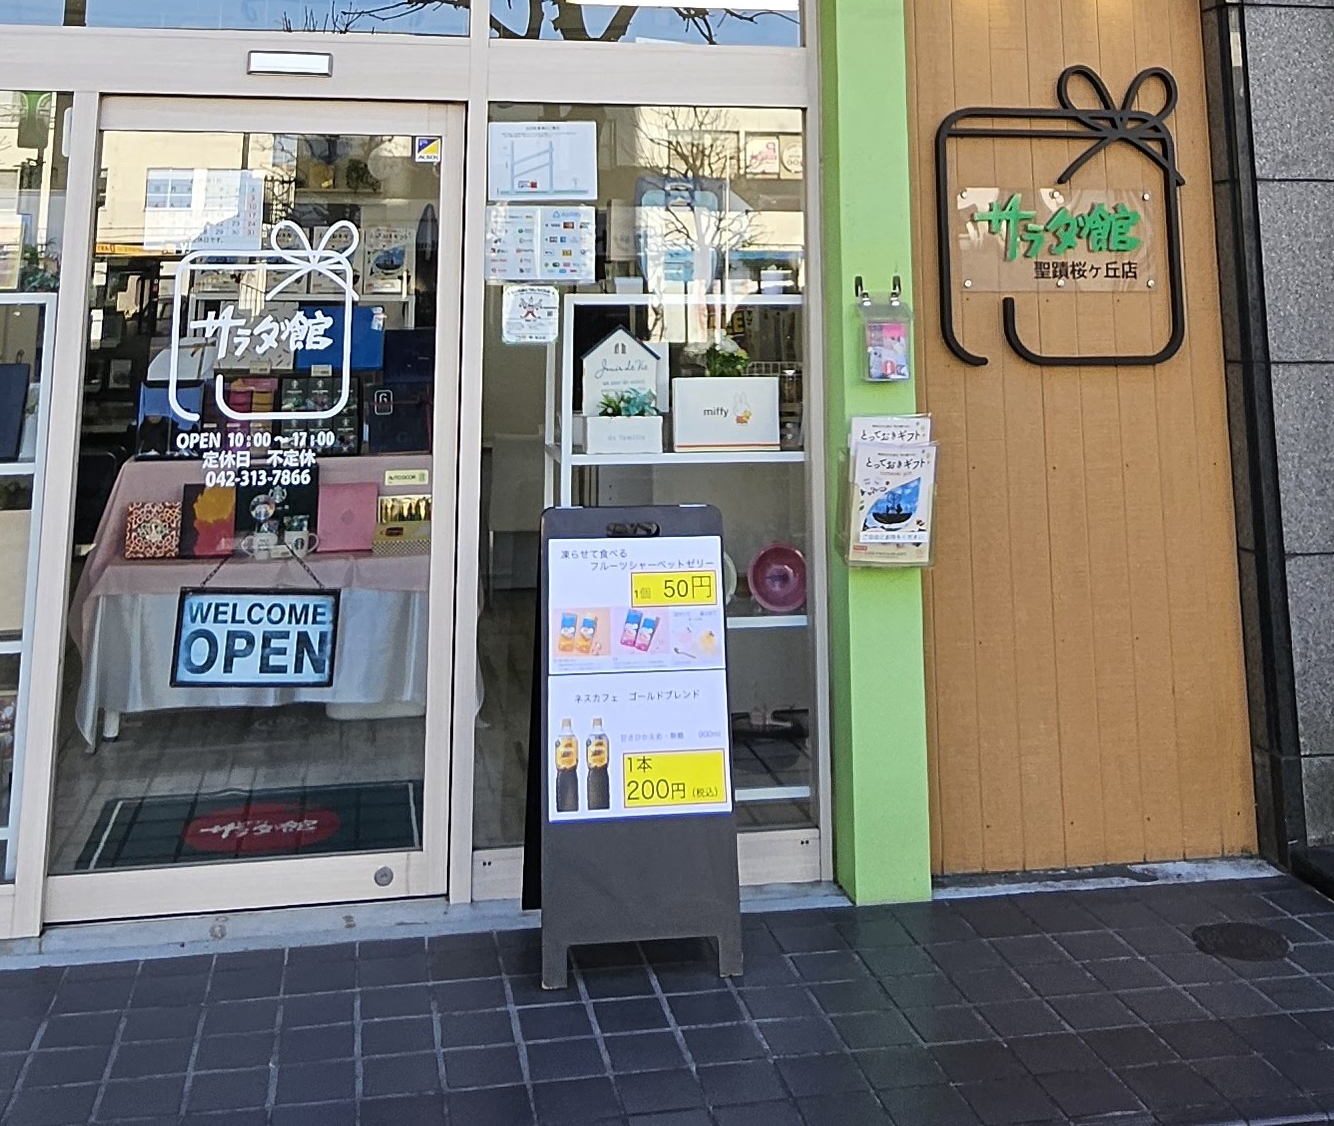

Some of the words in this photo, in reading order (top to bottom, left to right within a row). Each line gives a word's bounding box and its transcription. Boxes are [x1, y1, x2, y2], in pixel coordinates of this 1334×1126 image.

[974, 193, 1142, 262] サラダ館
[190, 305, 334, 360] サラダ館
[703, 406, 729, 419] miffy
[176, 432, 221, 450] OPEN
[202, 450, 251, 469] 定休日
[267, 449, 316, 468] 不定休
[205, 469, 311, 488] 042-313-7866
[560, 548, 628, 559] 凍らせて食べる
[590, 559, 716, 571] フルーツシャーベットゼリー
[634, 587, 652, 599] 1個
[663, 575, 712, 599] 50円
[188, 601, 328, 626] WELCOME
[182, 629, 329, 675] OPEN
[574, 693, 618, 704] ネスカフェ
[629, 689, 700, 702] ゴールドブレンド
[627, 755, 653, 773] 1本
[626, 778, 686, 801] 200円
